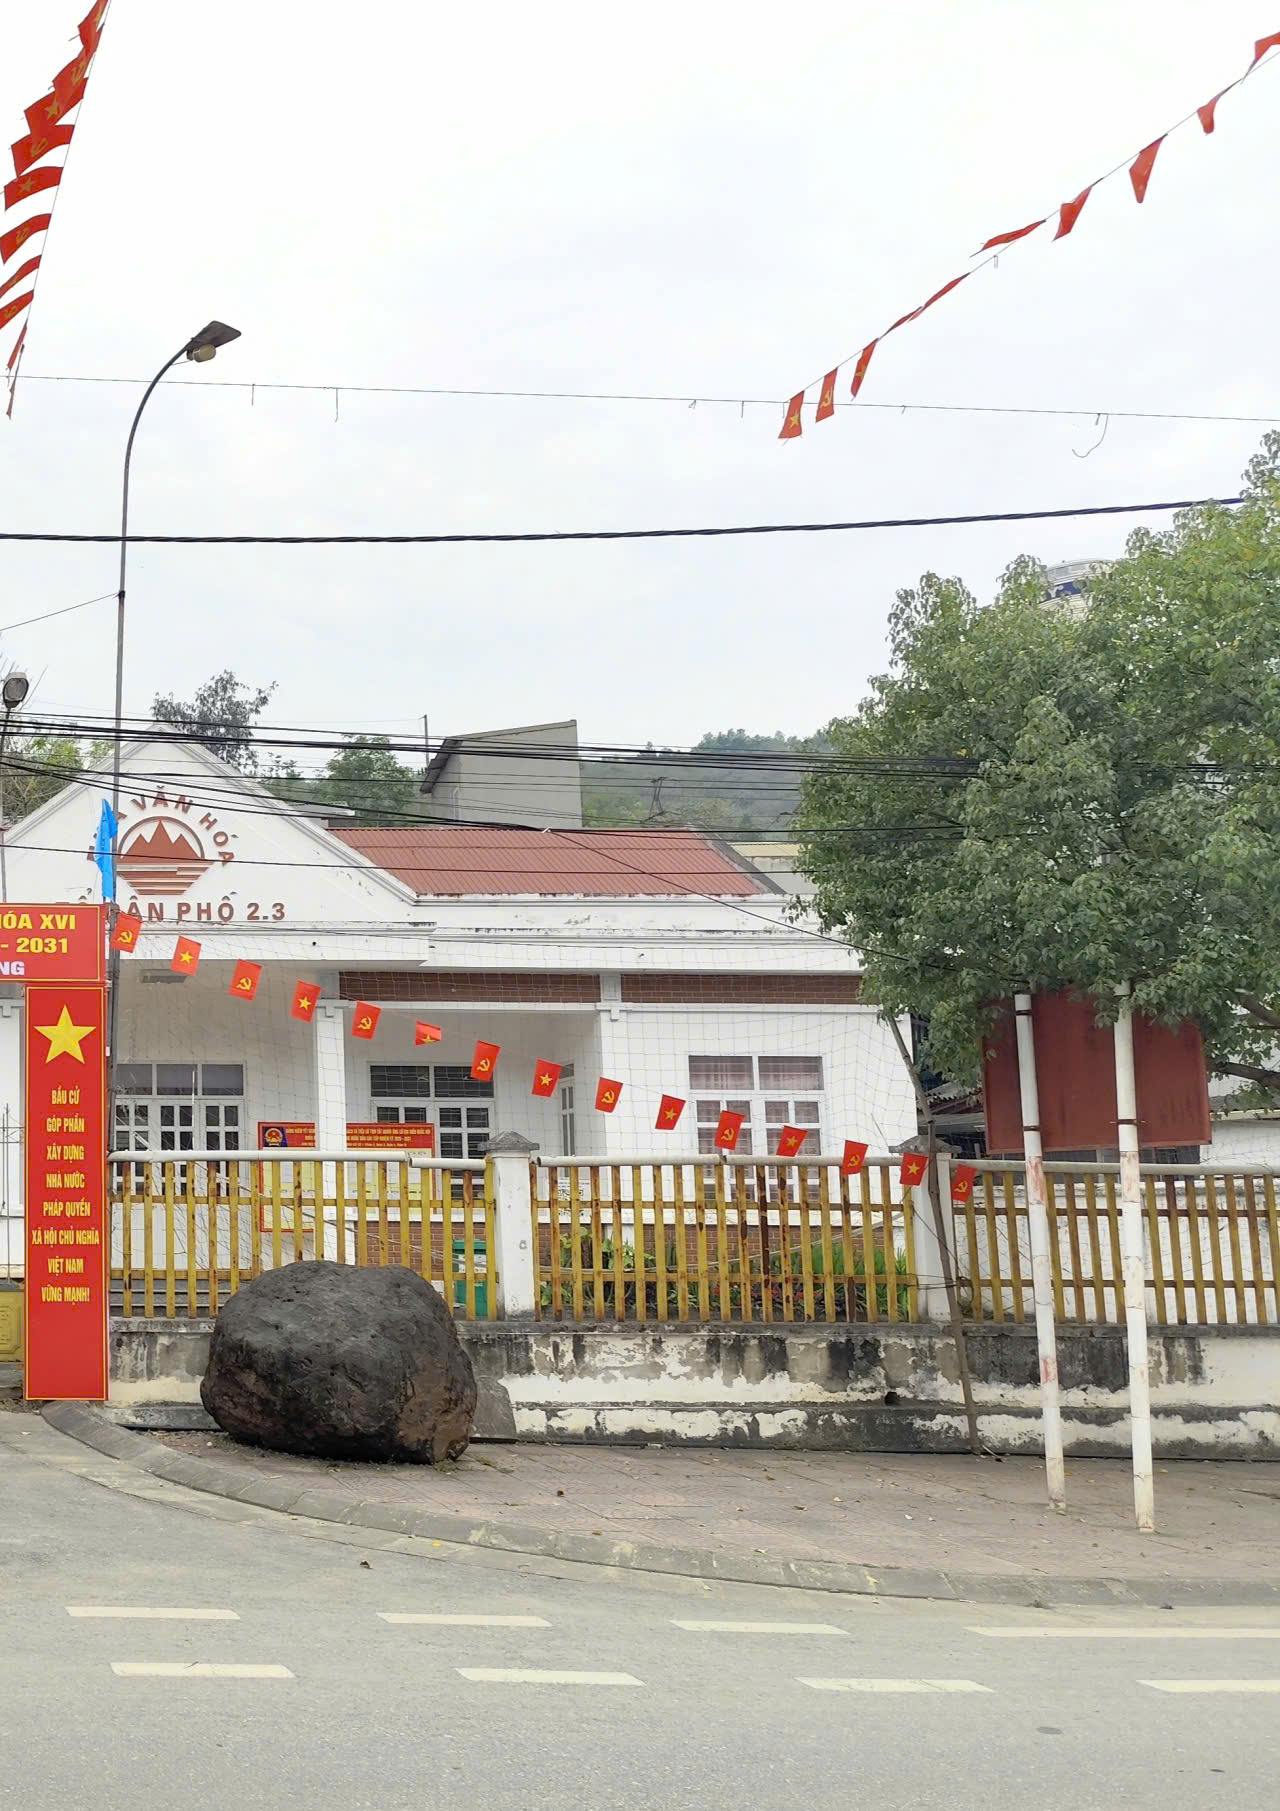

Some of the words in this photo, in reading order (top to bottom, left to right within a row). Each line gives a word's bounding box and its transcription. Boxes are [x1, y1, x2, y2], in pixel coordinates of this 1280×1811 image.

[177, 891, 239, 922] PHỐ
[246, 902, 286, 921] 2.3
[40, 913, 76, 930] XVI
[16, 937, 69, 953] 2031
[52, 1086, 67, 1104] BẦU
[69, 1085, 79, 1104] CỬ
[47, 1114, 62, 1132] GÓP
[64, 1113, 84, 1132] PHẦN
[47, 1143, 62, 1160] XÂY
[64, 1146, 84, 1163] DỰNG
[46, 1171, 62, 1188] NHÀ
[64, 1172, 85, 1188] NƯỚC
[43, 1200, 64, 1216] PHÁP
[65, 1197, 90, 1217] QUYỀN
[32, 1228, 42, 1244] XÃ
[44, 1228, 57, 1247] HỘI
[59, 1226, 74, 1245] CHỦ
[76, 1228, 99, 1245] NGHĨA
[48, 1256, 64, 1276] VIỆT
[66, 1258, 83, 1273] NAM
[41, 1284, 62, 1302] VỮNG
[64, 1287, 90, 1305] MẠNH!
